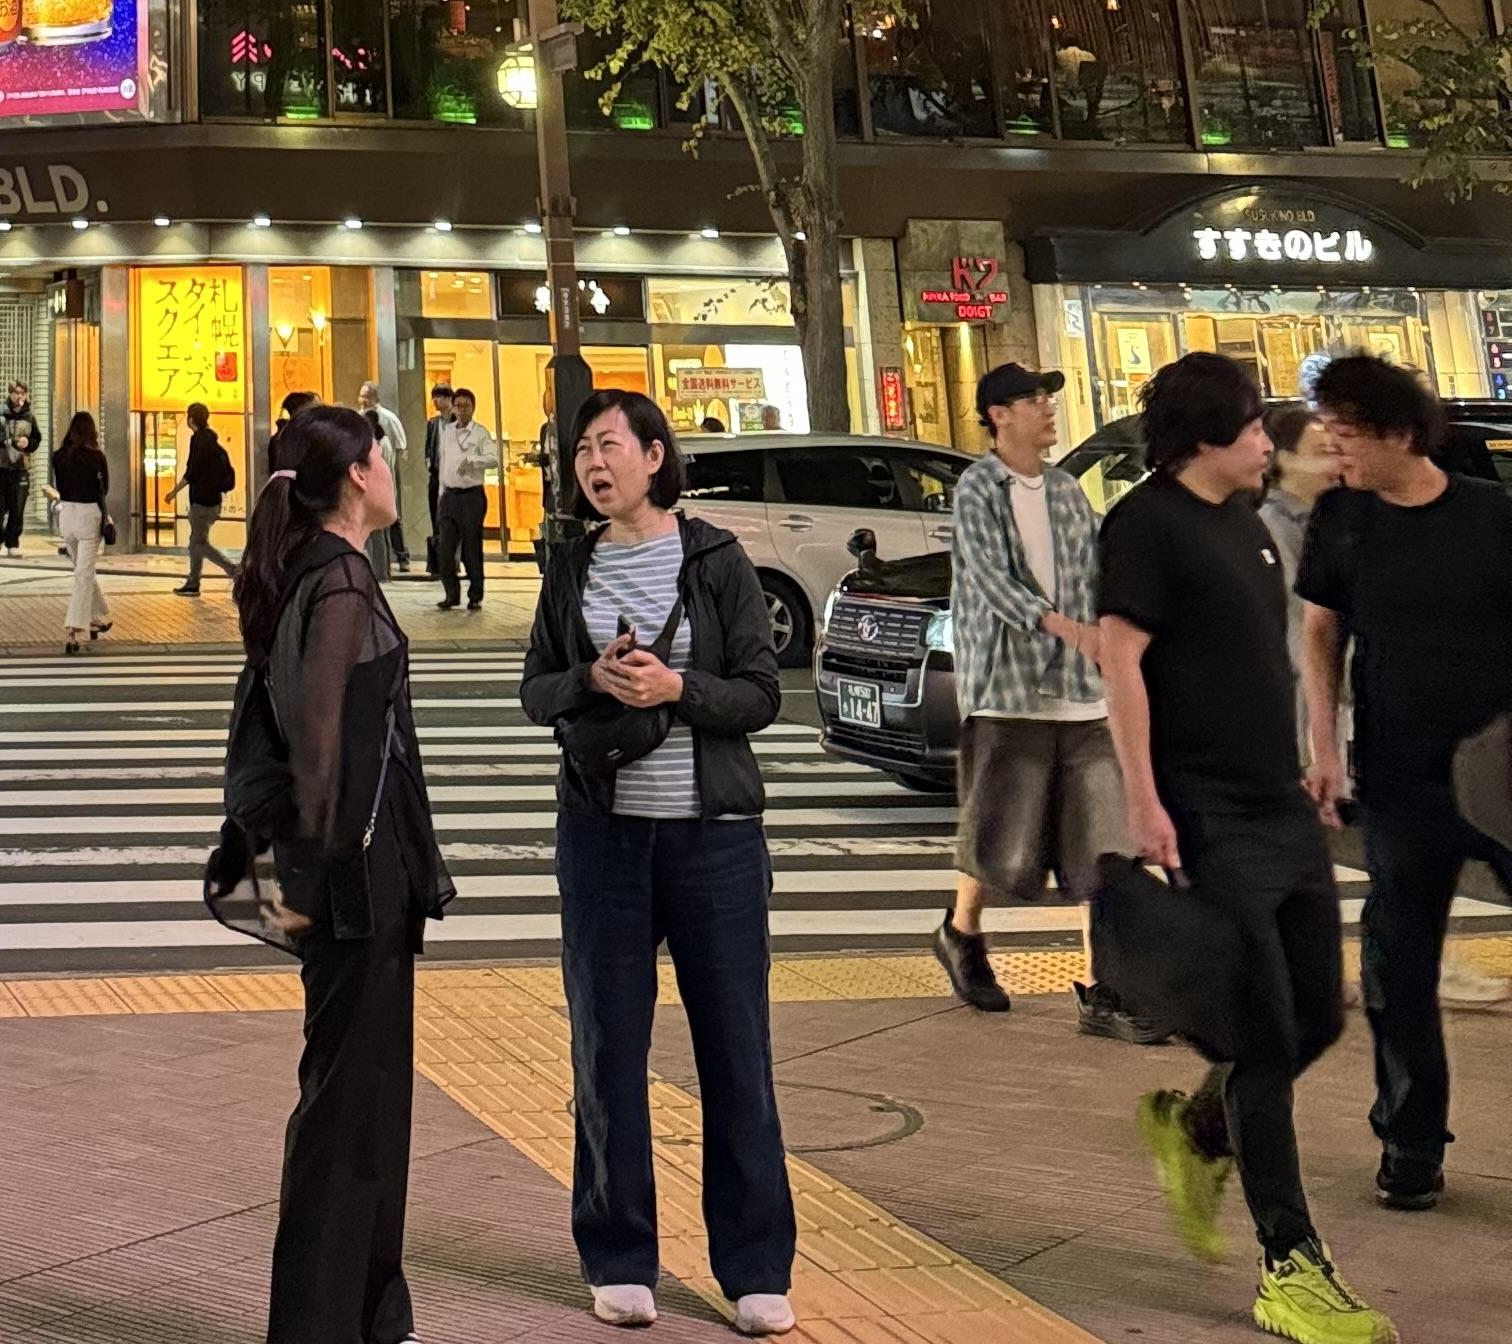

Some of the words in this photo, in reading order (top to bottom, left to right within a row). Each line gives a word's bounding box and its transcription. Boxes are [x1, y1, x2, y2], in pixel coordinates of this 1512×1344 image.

[1192, 227, 1373, 263] すすきのビル
[155, 279, 181, 398] スクエア
[209, 278, 239, 348] 札幌
[682, 377, 761, 390] 全国送料無料サービス
